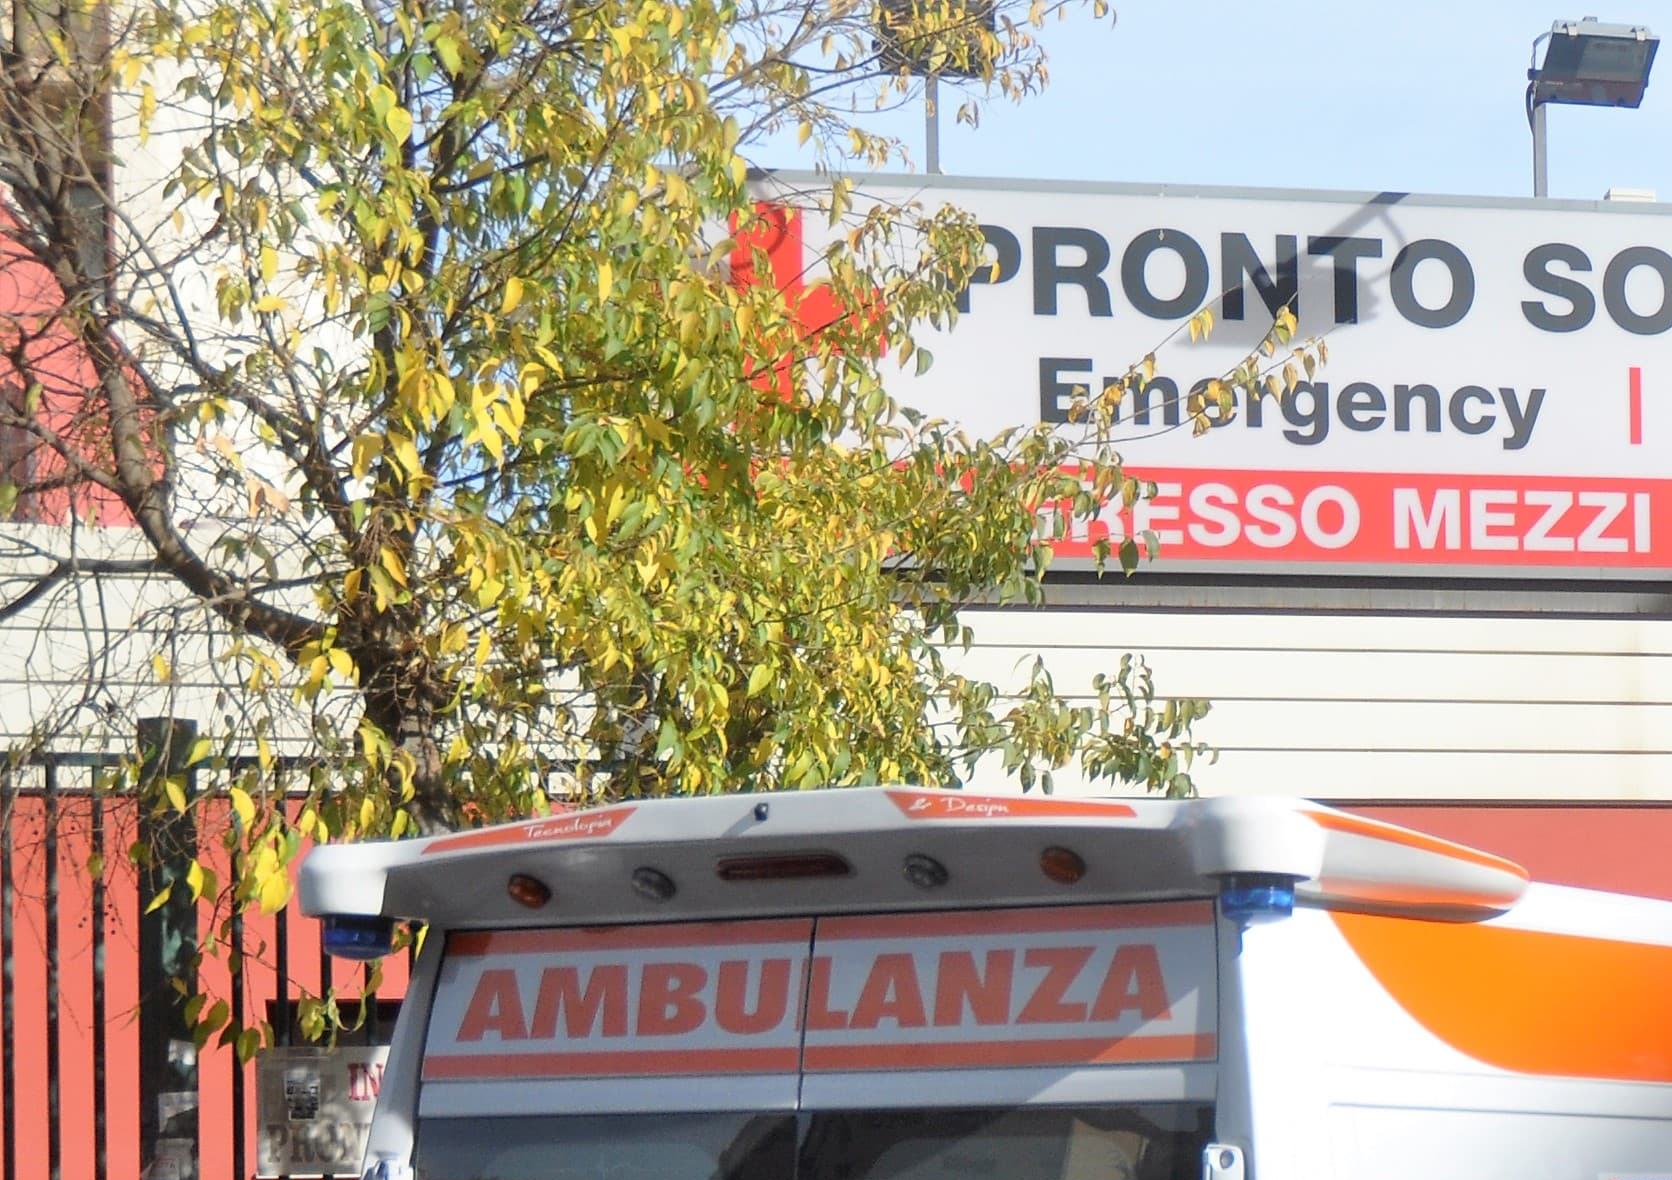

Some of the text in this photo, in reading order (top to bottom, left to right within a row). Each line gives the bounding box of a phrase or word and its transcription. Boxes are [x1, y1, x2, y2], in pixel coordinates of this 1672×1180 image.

[954, 224, 1476, 330] PRONTO
[1038, 356, 1547, 451] Emergency
[1393, 488, 1651, 554] MEZZI
[522, 814, 615, 839] Tecnologia
[940, 796, 1009, 817] Design
[454, 942, 1174, 1044] AMBULANZA
